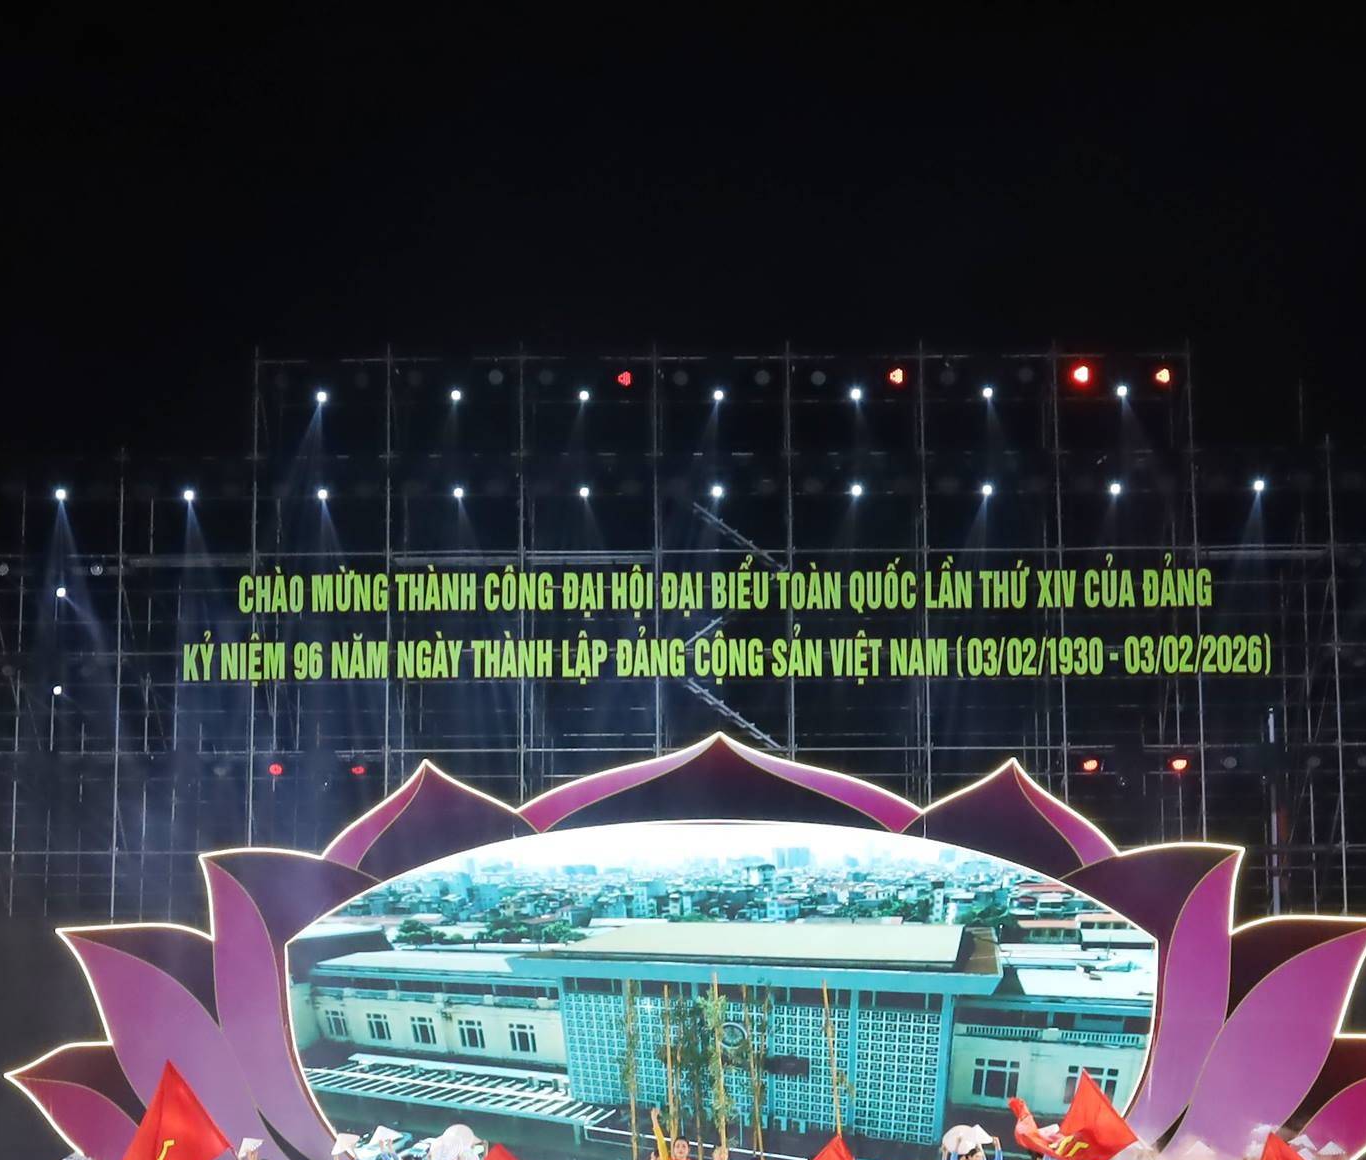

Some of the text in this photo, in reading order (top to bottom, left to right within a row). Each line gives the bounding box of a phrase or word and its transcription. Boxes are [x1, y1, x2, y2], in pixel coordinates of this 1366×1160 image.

[238, 554, 1212, 617] CHÀO MỪNG THÀNH CÔNG ĐẠI HỘI ĐẠI BIỂU TOÀN QUỐC LẦN THỨ XIV CỦA ĐẢNG
[183, 630, 214, 680] KỶ
[220, 633, 286, 686] NIỆM
[293, 641, 324, 680] 96
[331, 632, 389, 679] NĂM
[397, 630, 463, 679] NGÀY
[472, 630, 553, 678] THÀNH
[561, 630, 608, 685] LẬP
[615, 625, 686, 677] ĐẢNG
[694, 630, 764, 685] CỘNG
[771, 624, 823, 678] SẢN
[829, 629, 883, 685] VIỆT
[889, 638, 948, 676] NAM
[956, 636, 1104, 677] (03/02/1930
[1124, 635, 1272, 674] 03/02/2026)
